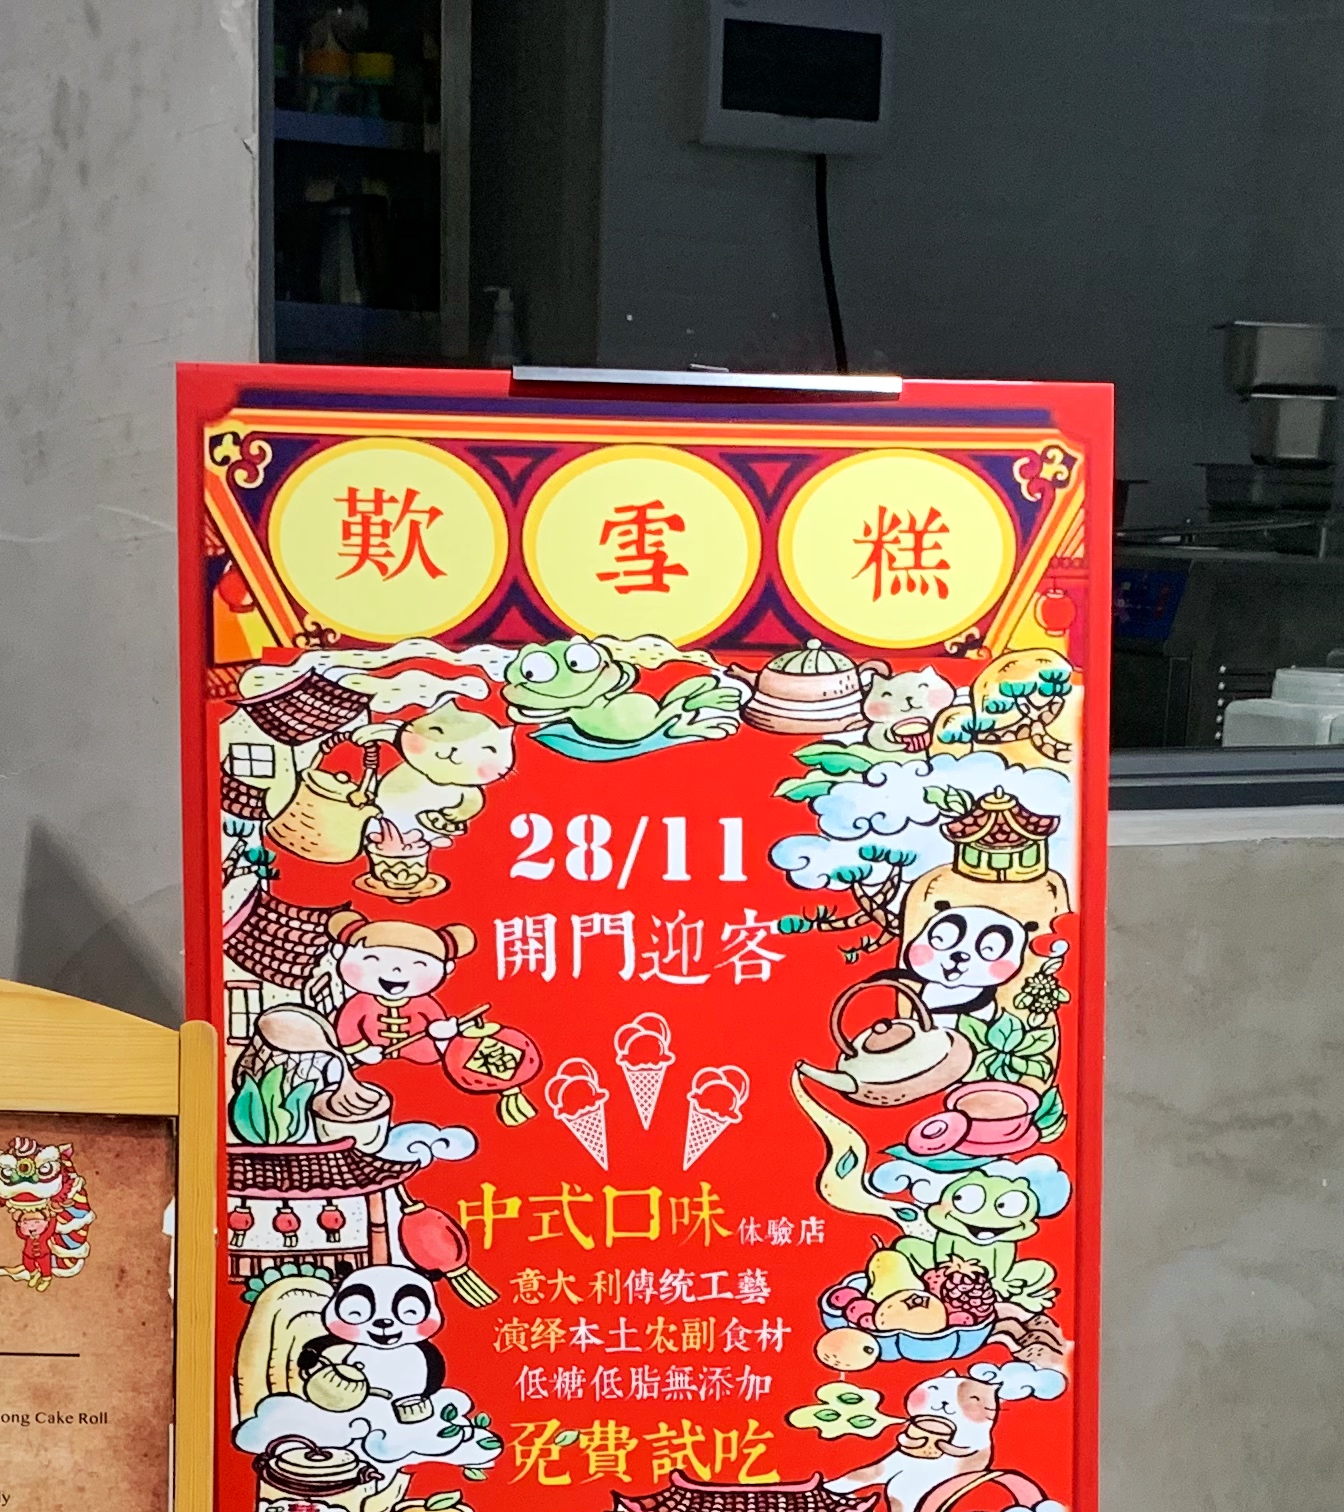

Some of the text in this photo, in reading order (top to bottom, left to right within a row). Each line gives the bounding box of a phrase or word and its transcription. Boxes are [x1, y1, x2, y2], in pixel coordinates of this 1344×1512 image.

[510, 809, 749, 891] 28/11
[493, 909, 787, 986] 開門迎客
[457, 1181, 733, 1250] 中式口味
[36, 1411, 74, 1424] Cake
[78, 1412, 107, 1424] Roll
[515, 1364, 772, 1402] 低糖低脂無添加
